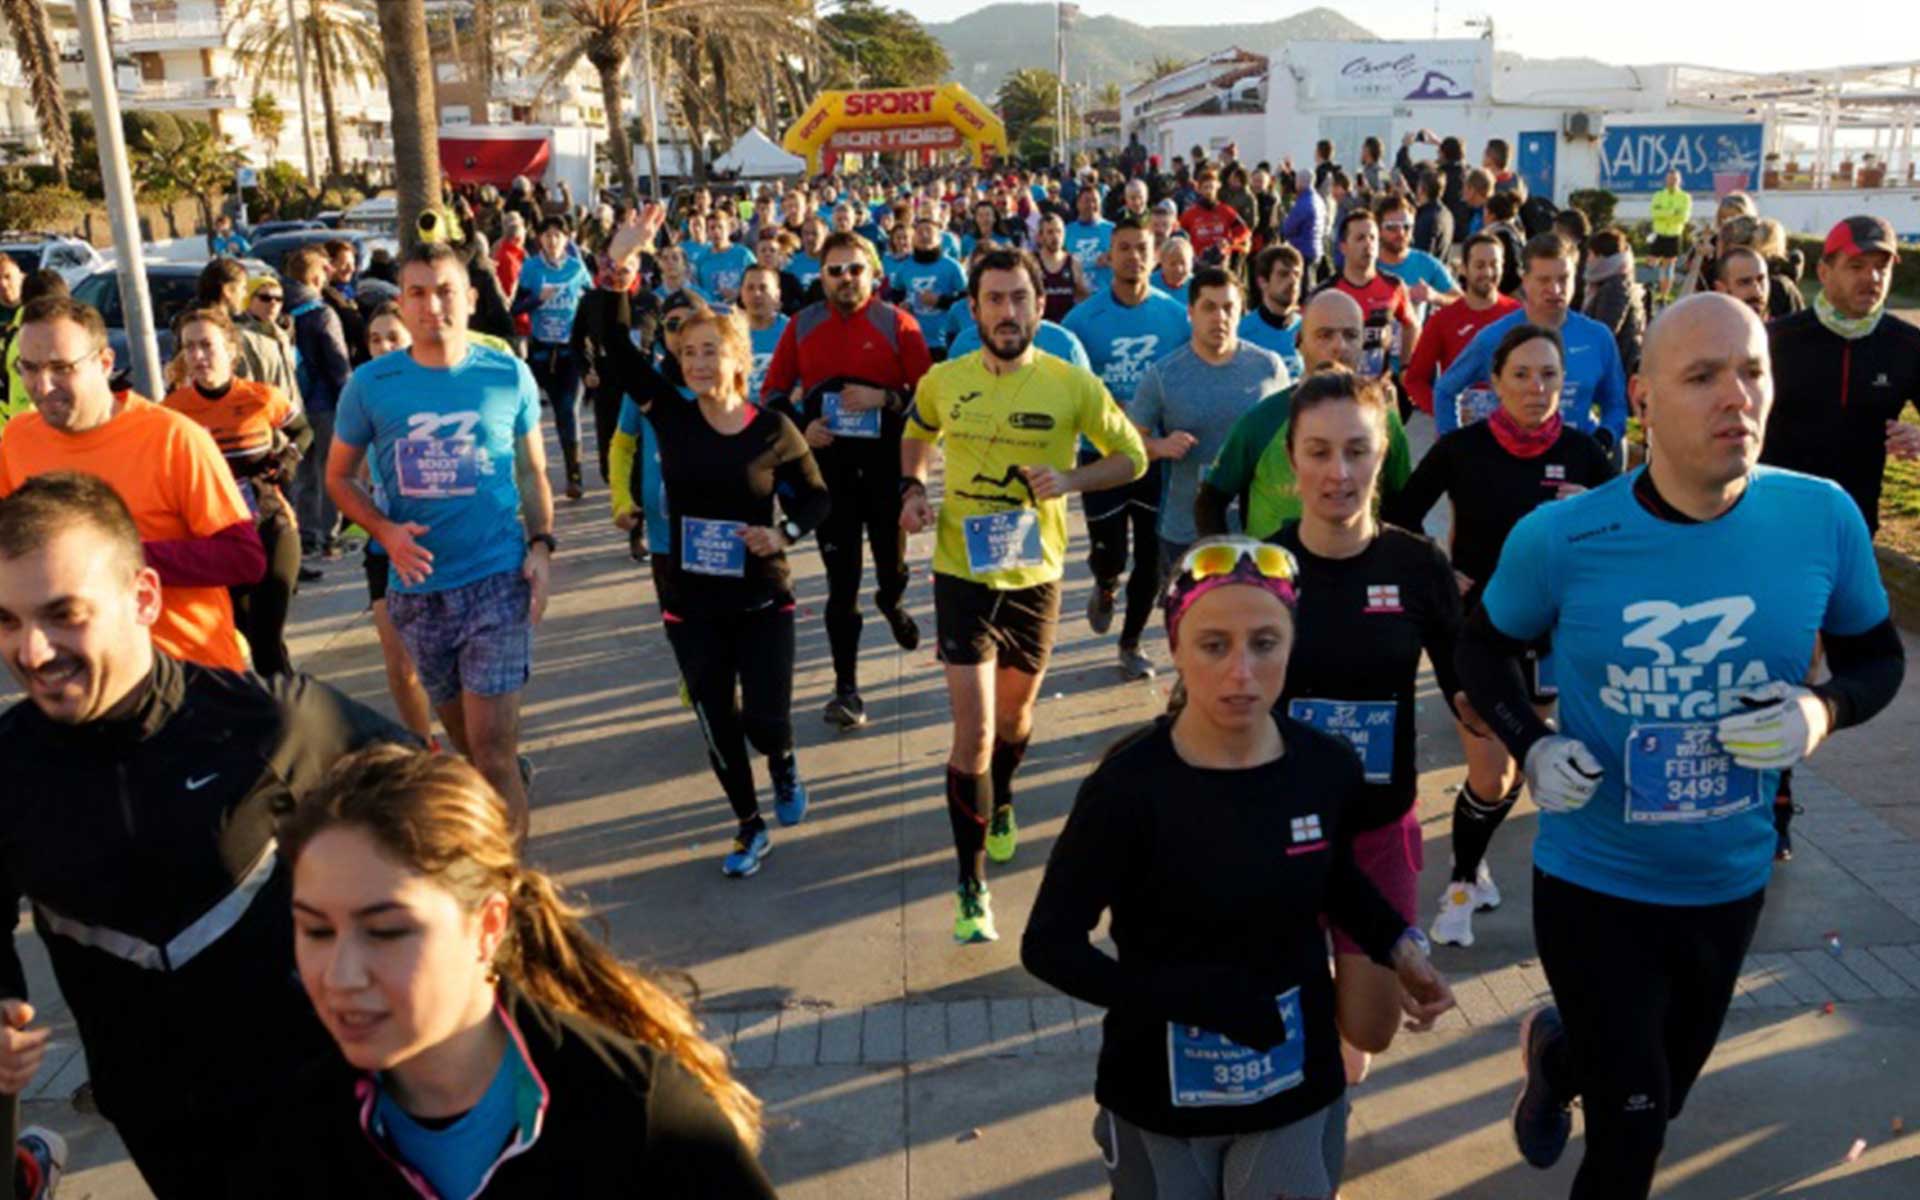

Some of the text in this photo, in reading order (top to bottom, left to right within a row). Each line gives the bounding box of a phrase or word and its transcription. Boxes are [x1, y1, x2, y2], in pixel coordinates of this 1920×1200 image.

[844, 90, 935, 116] SPORT
[1111, 334, 1158, 361] 37
[1622, 596, 1755, 665] 37
[1600, 687, 1746, 718] SITGE
[1665, 757, 1729, 779] FELIPE
[1667, 776, 1728, 800] 3493
[1213, 1056, 1274, 1084] 3381
